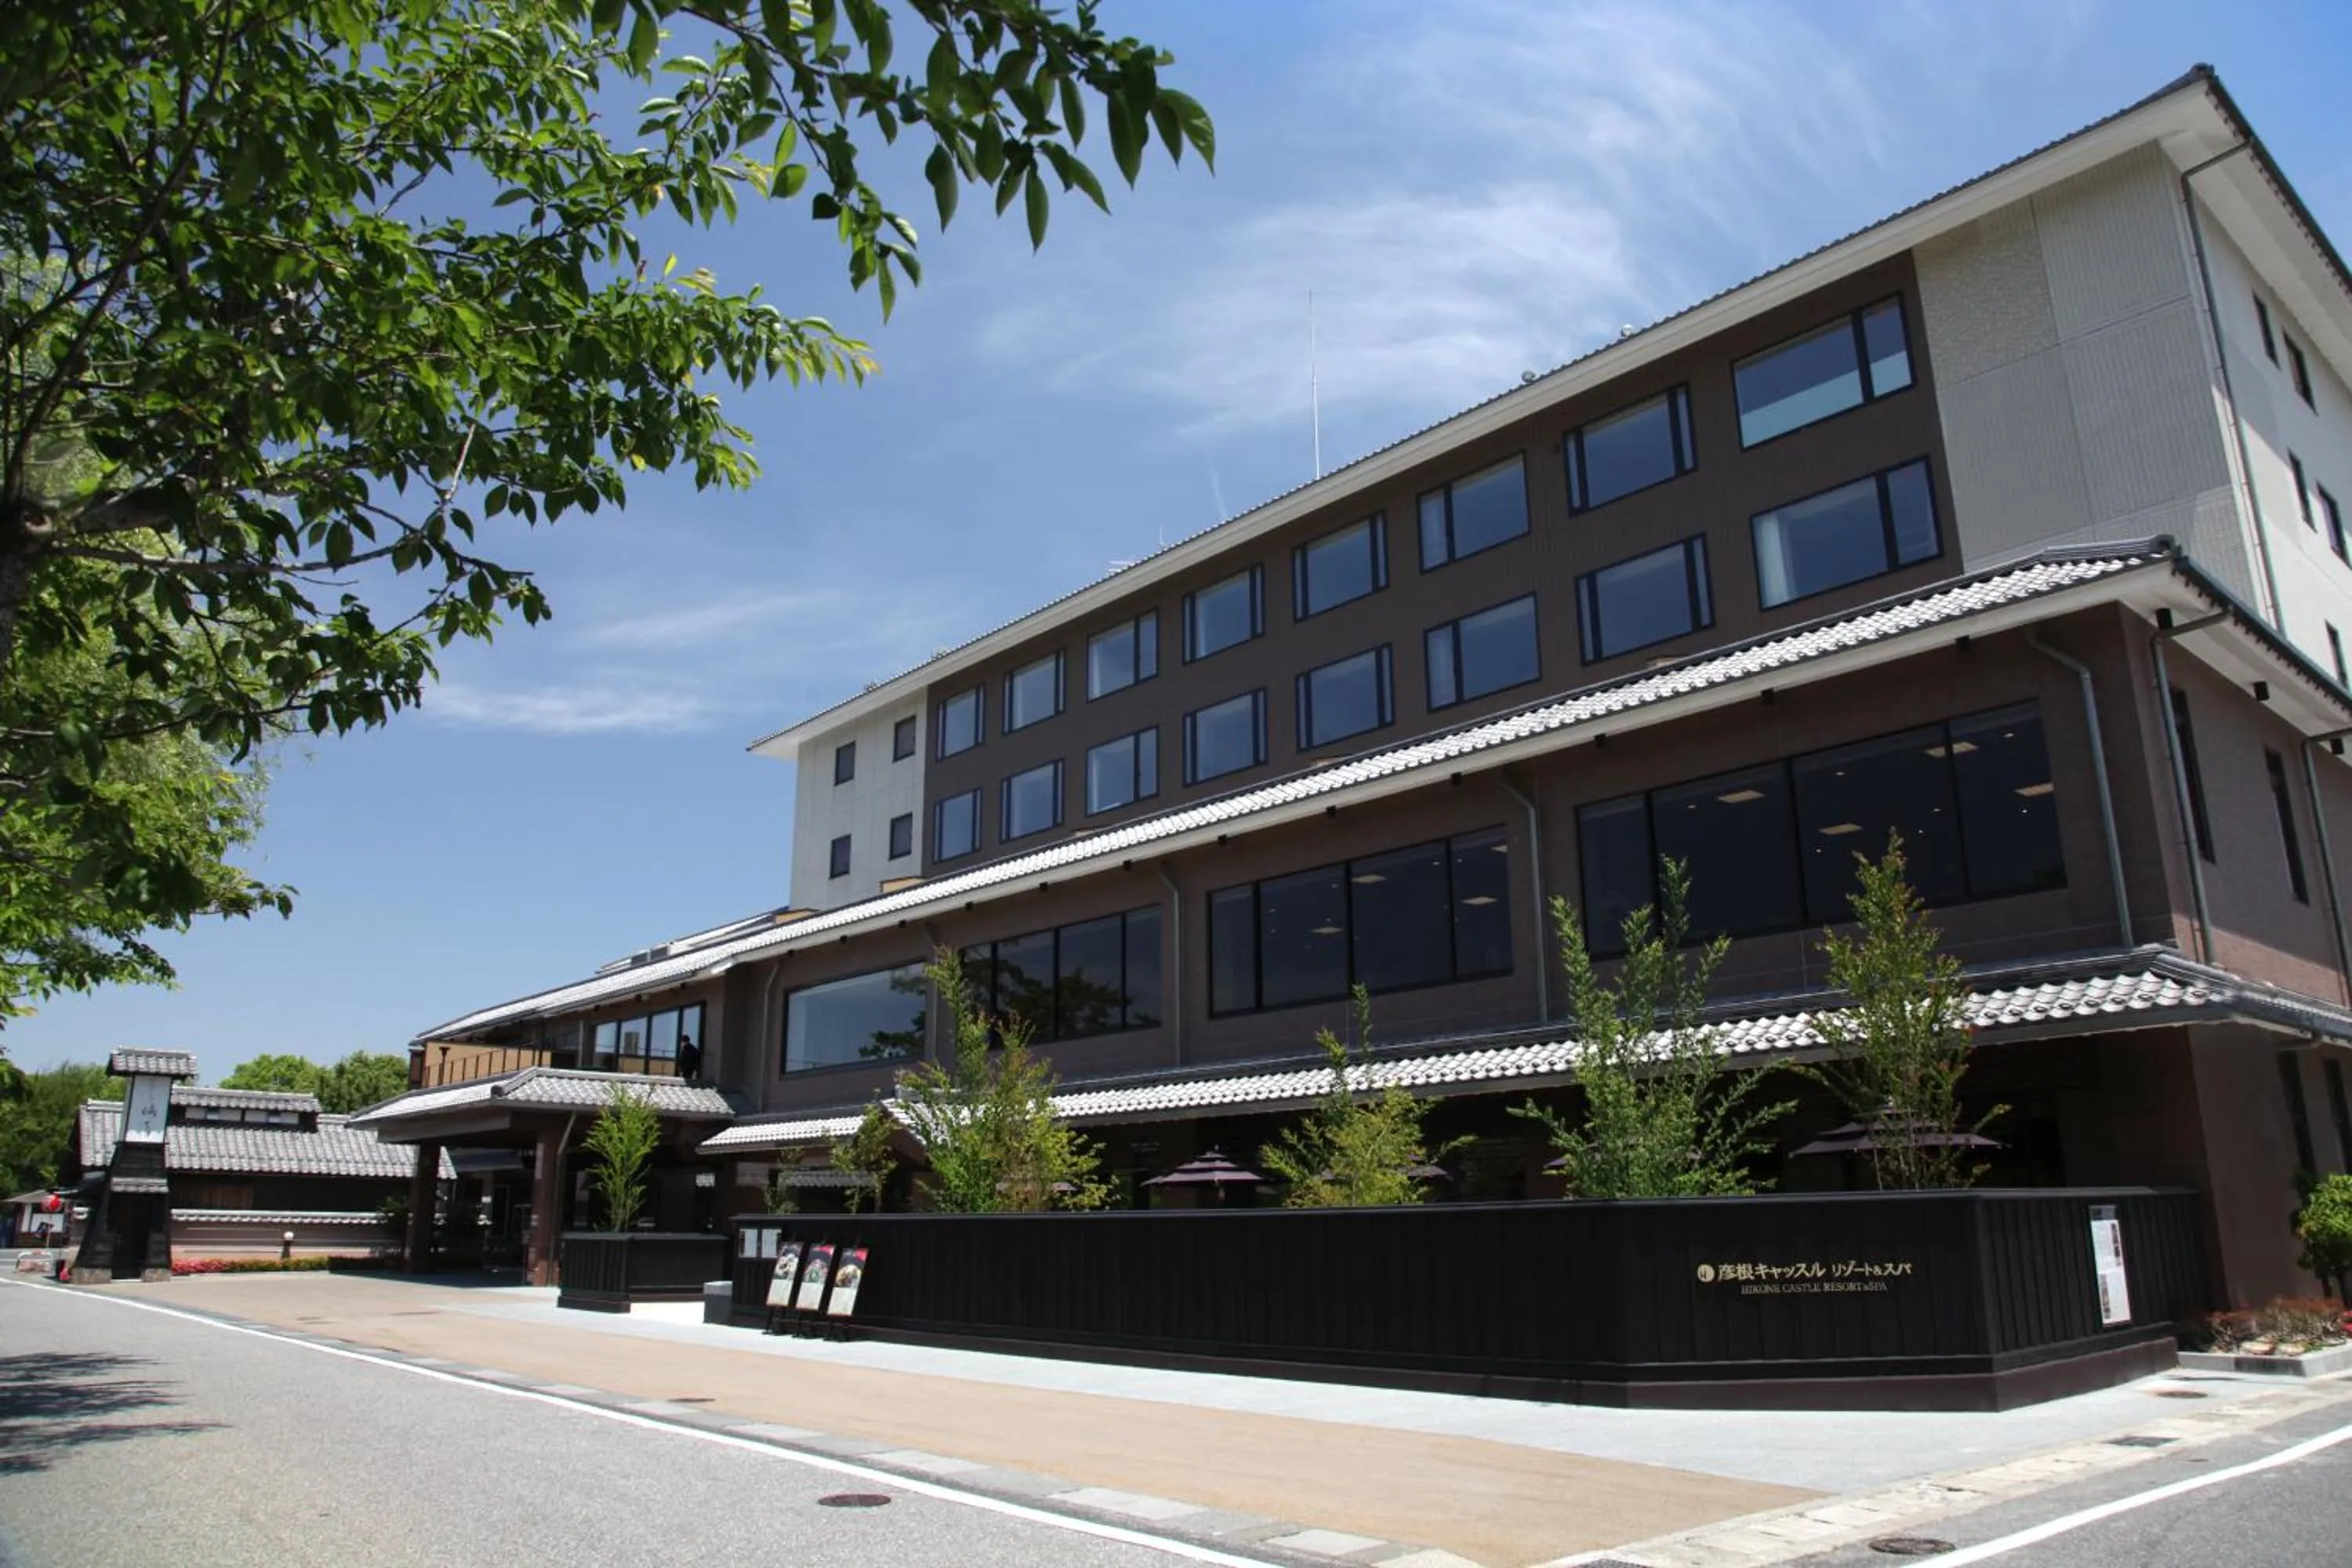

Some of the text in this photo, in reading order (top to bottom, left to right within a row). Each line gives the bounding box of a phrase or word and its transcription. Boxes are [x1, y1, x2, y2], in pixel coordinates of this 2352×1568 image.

[1718, 1261, 1826, 1281] 彦根キャッスル
